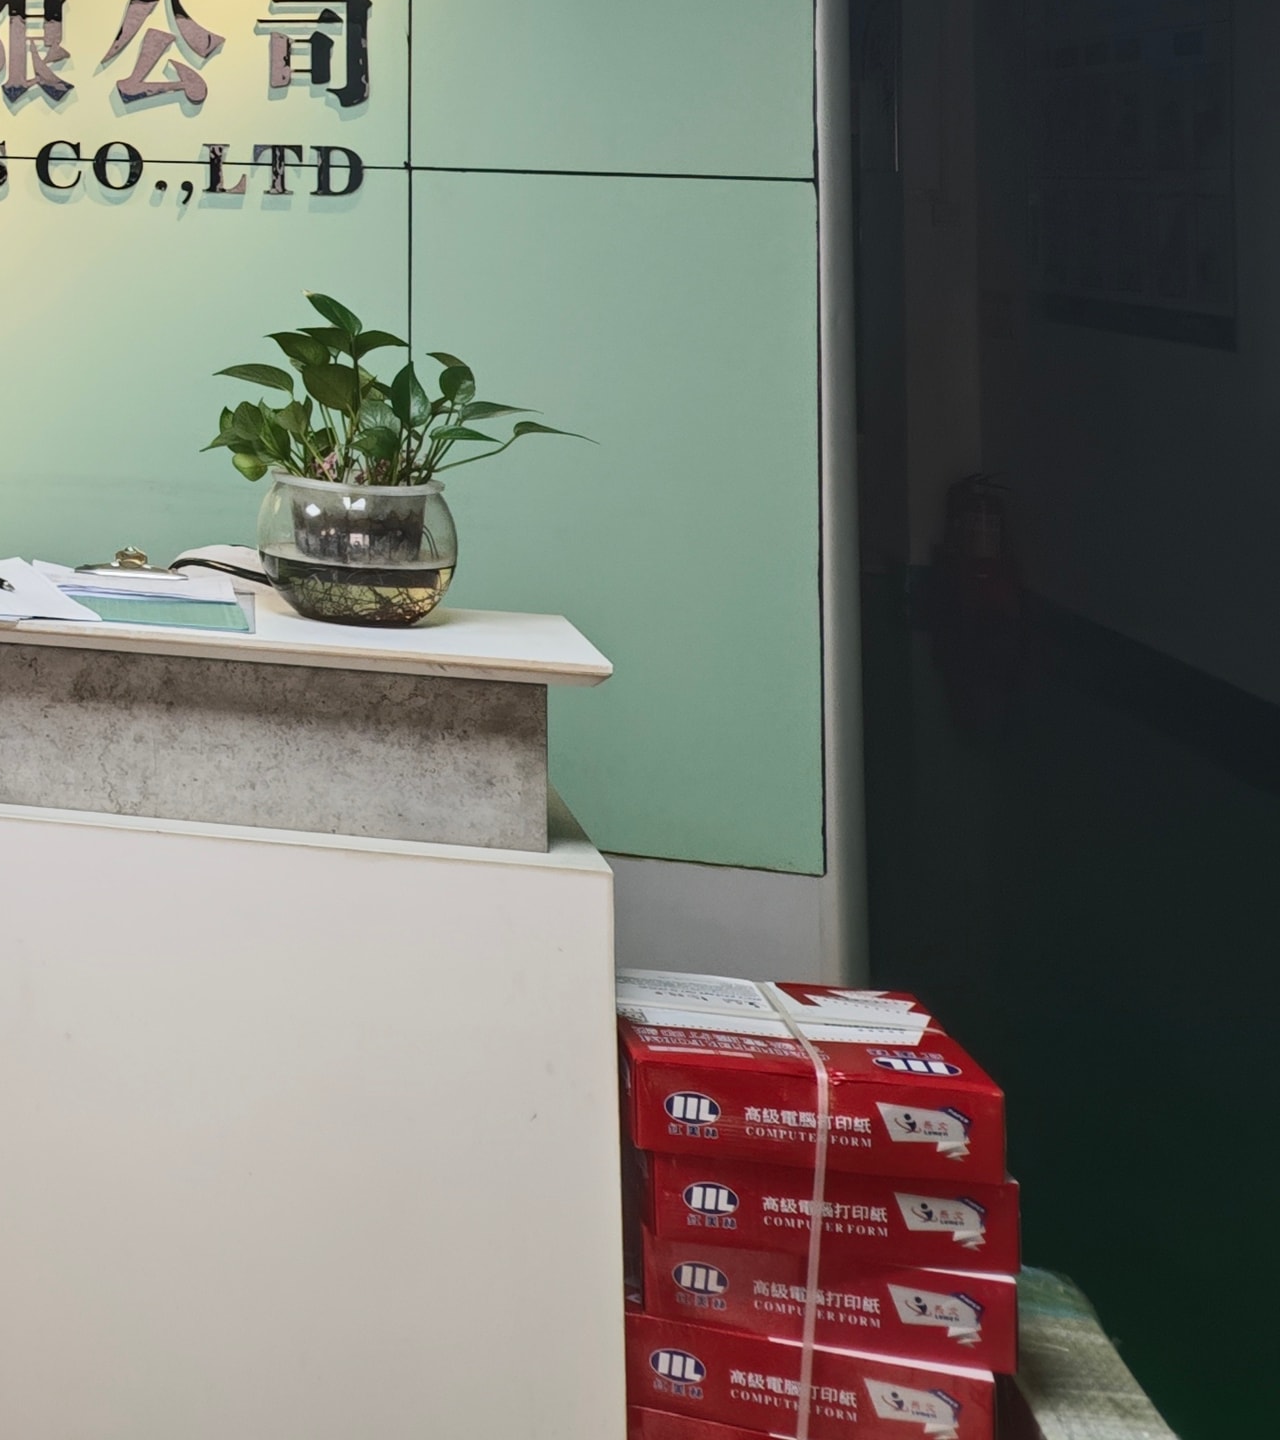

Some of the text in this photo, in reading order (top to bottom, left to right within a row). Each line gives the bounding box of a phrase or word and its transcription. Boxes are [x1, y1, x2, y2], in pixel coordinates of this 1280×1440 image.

[745, 1125, 872, 1149] COMPUTE FORM
[847, 1223, 889, 1238] FORM
[753, 1299, 881, 1329] COMPUER FORM
[730, 1388, 858, 1423] COMPUTE FORM
